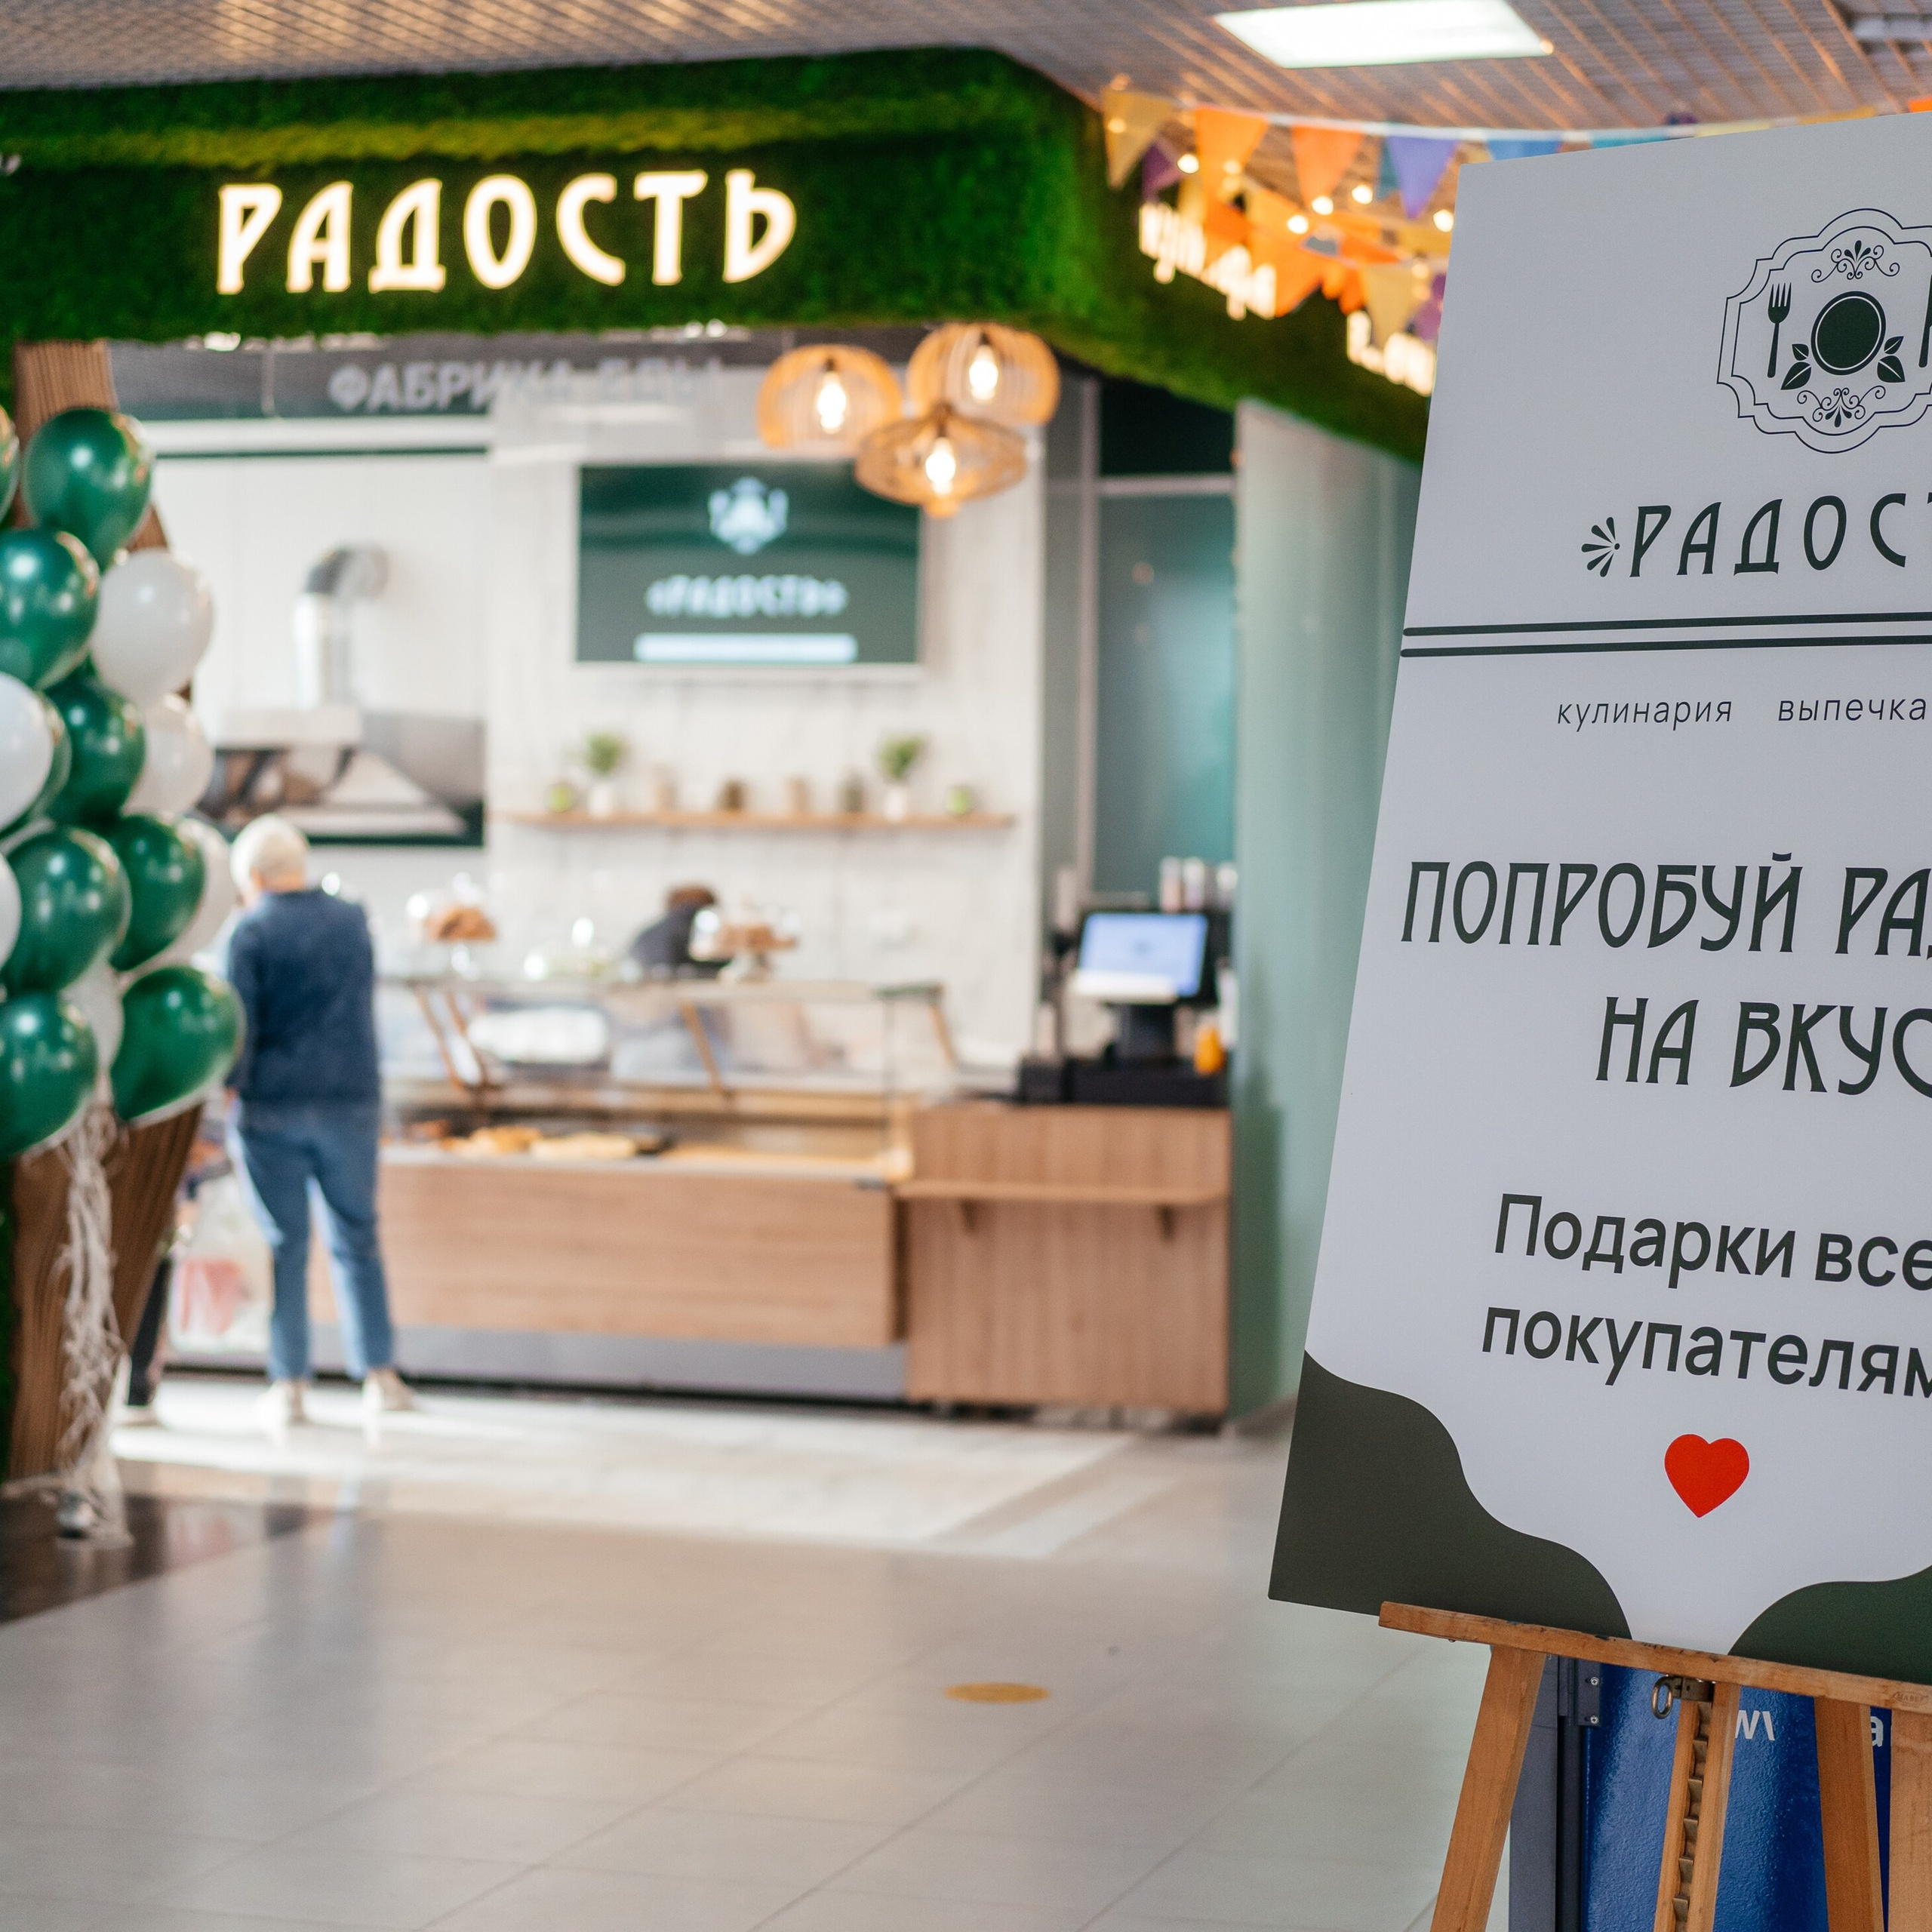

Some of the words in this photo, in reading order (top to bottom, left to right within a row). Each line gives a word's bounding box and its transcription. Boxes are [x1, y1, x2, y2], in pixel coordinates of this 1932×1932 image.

[217, 168, 796, 294] РАДОСТЬ
[1630, 492, 1932, 577] РАДОС
[1557, 700, 1732, 732] кулинария
[1778, 698, 1927, 721] выпечка
[1401, 852, 1804, 953] ПОПРОБУЙ
[1835, 867, 1932, 961] РА
[1595, 996, 1700, 1085] НА
[1729, 1001, 1932, 1099] ВКУС
[1494, 1193, 1796, 1289] Подарки
